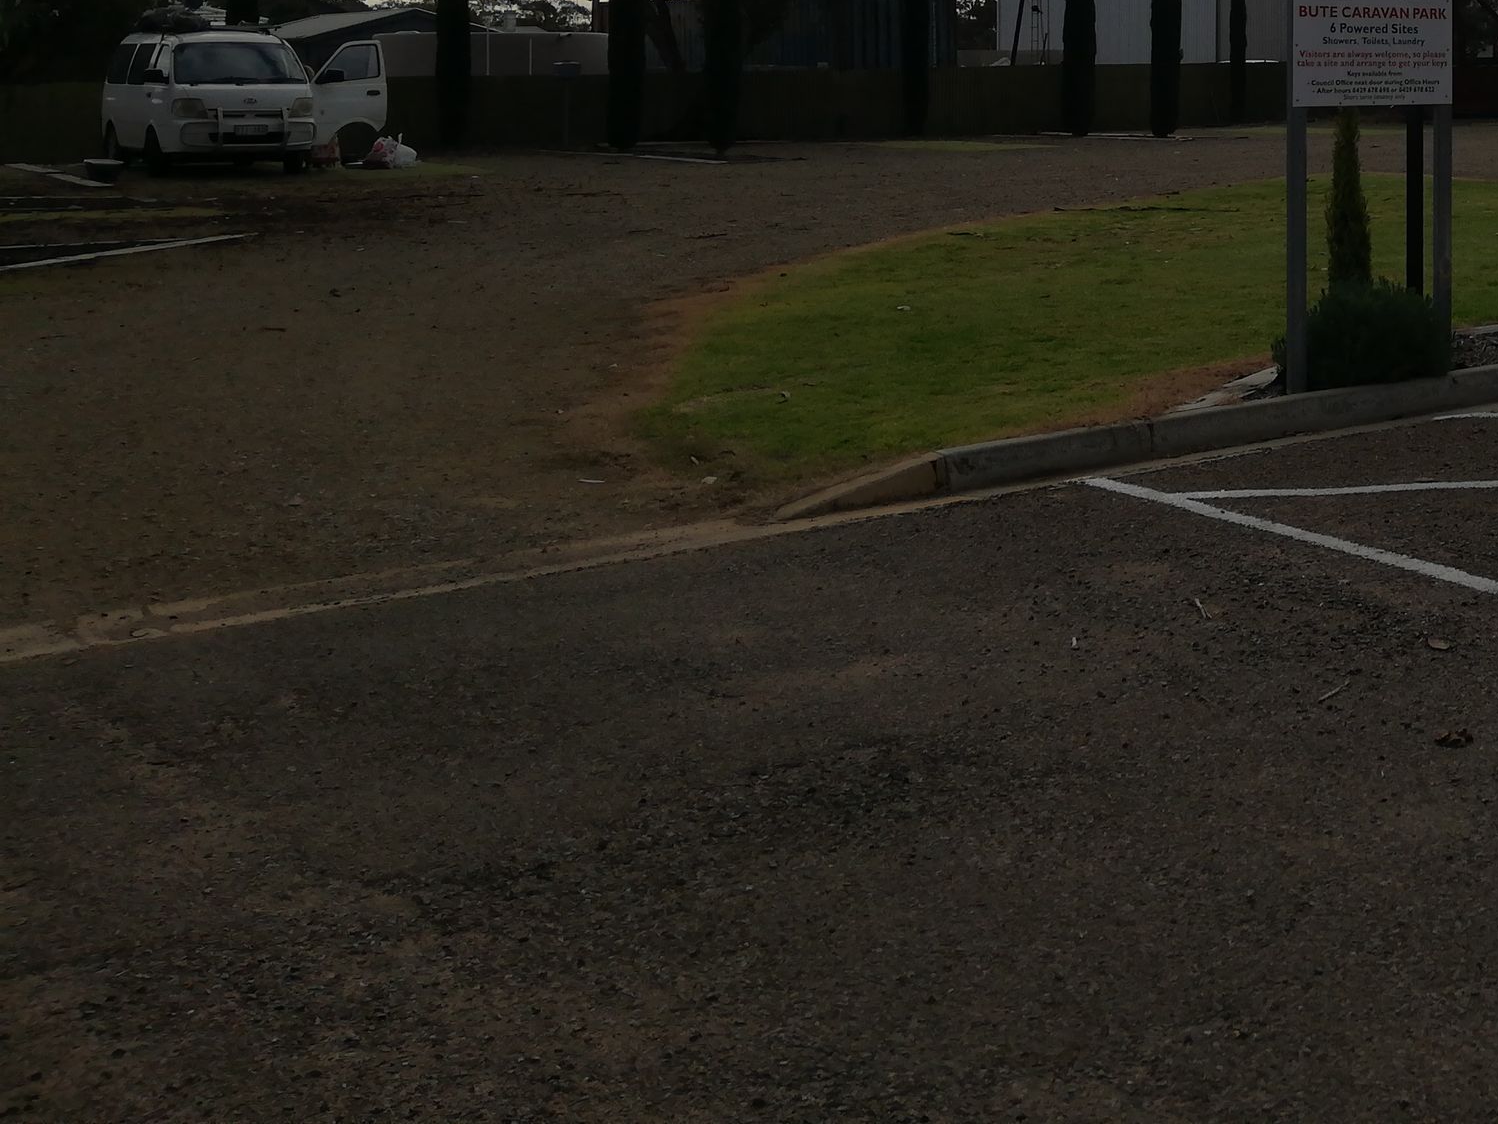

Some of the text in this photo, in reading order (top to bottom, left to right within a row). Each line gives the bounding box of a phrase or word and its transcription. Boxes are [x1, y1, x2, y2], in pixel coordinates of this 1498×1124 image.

[1299, 6, 1447, 19] BUTE CARAVAN PARK
[1330, 22, 1418, 34] 6 Powered Sites
[1322, 37, 1425, 47] Showers, Toilets, Laundry
[1299, 50, 1330, 58] Visitors
[1347, 50, 1372, 60] always
[1375, 50, 1411, 59] welcome,
[1423, 51, 1446, 60] please
[1356, 61, 1386, 69] arrange
[1398, 61, 1411, 69] get
[1413, 61, 1431, 69] your
[1431, 60, 1448, 69] keys
